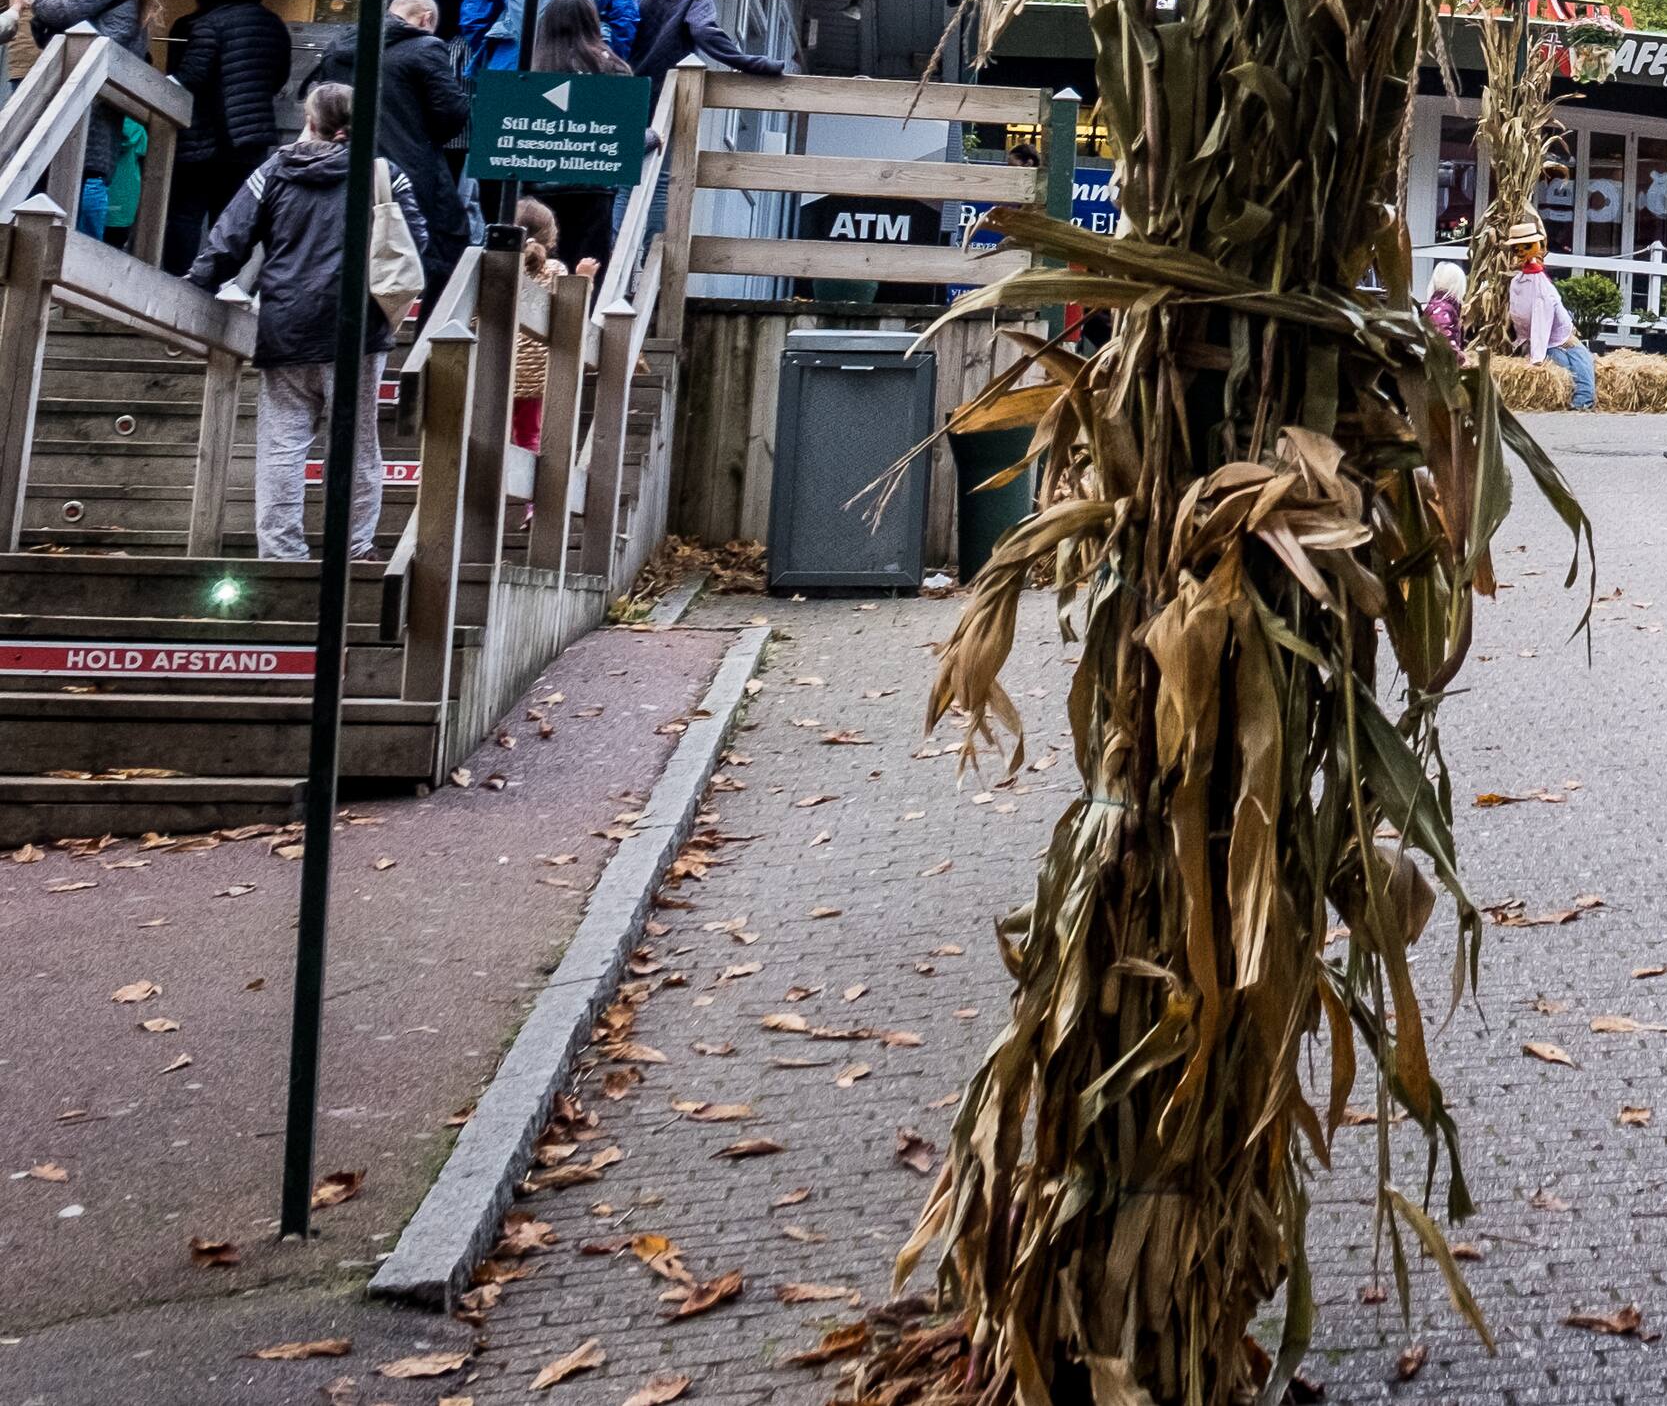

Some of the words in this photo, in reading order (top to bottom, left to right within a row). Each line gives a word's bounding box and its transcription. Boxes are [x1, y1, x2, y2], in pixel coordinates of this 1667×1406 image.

[501, 116, 529, 131] Stil
[531, 118, 556, 135] dig
[558, 120, 565, 132] i
[567, 120, 587, 134] kø
[589, 121, 617, 134] her
[496, 135, 515, 148] til
[517, 138, 597, 153] sæsonkort
[599, 142, 618, 156] og
[489, 154, 557, 172] webshop
[559, 157, 622, 172] billetter
[829, 212, 911, 241] ATM
[381, 466, 408, 480] LD
[66, 649, 143, 670] HOLD
[151, 651, 278, 672] AFSTAND
